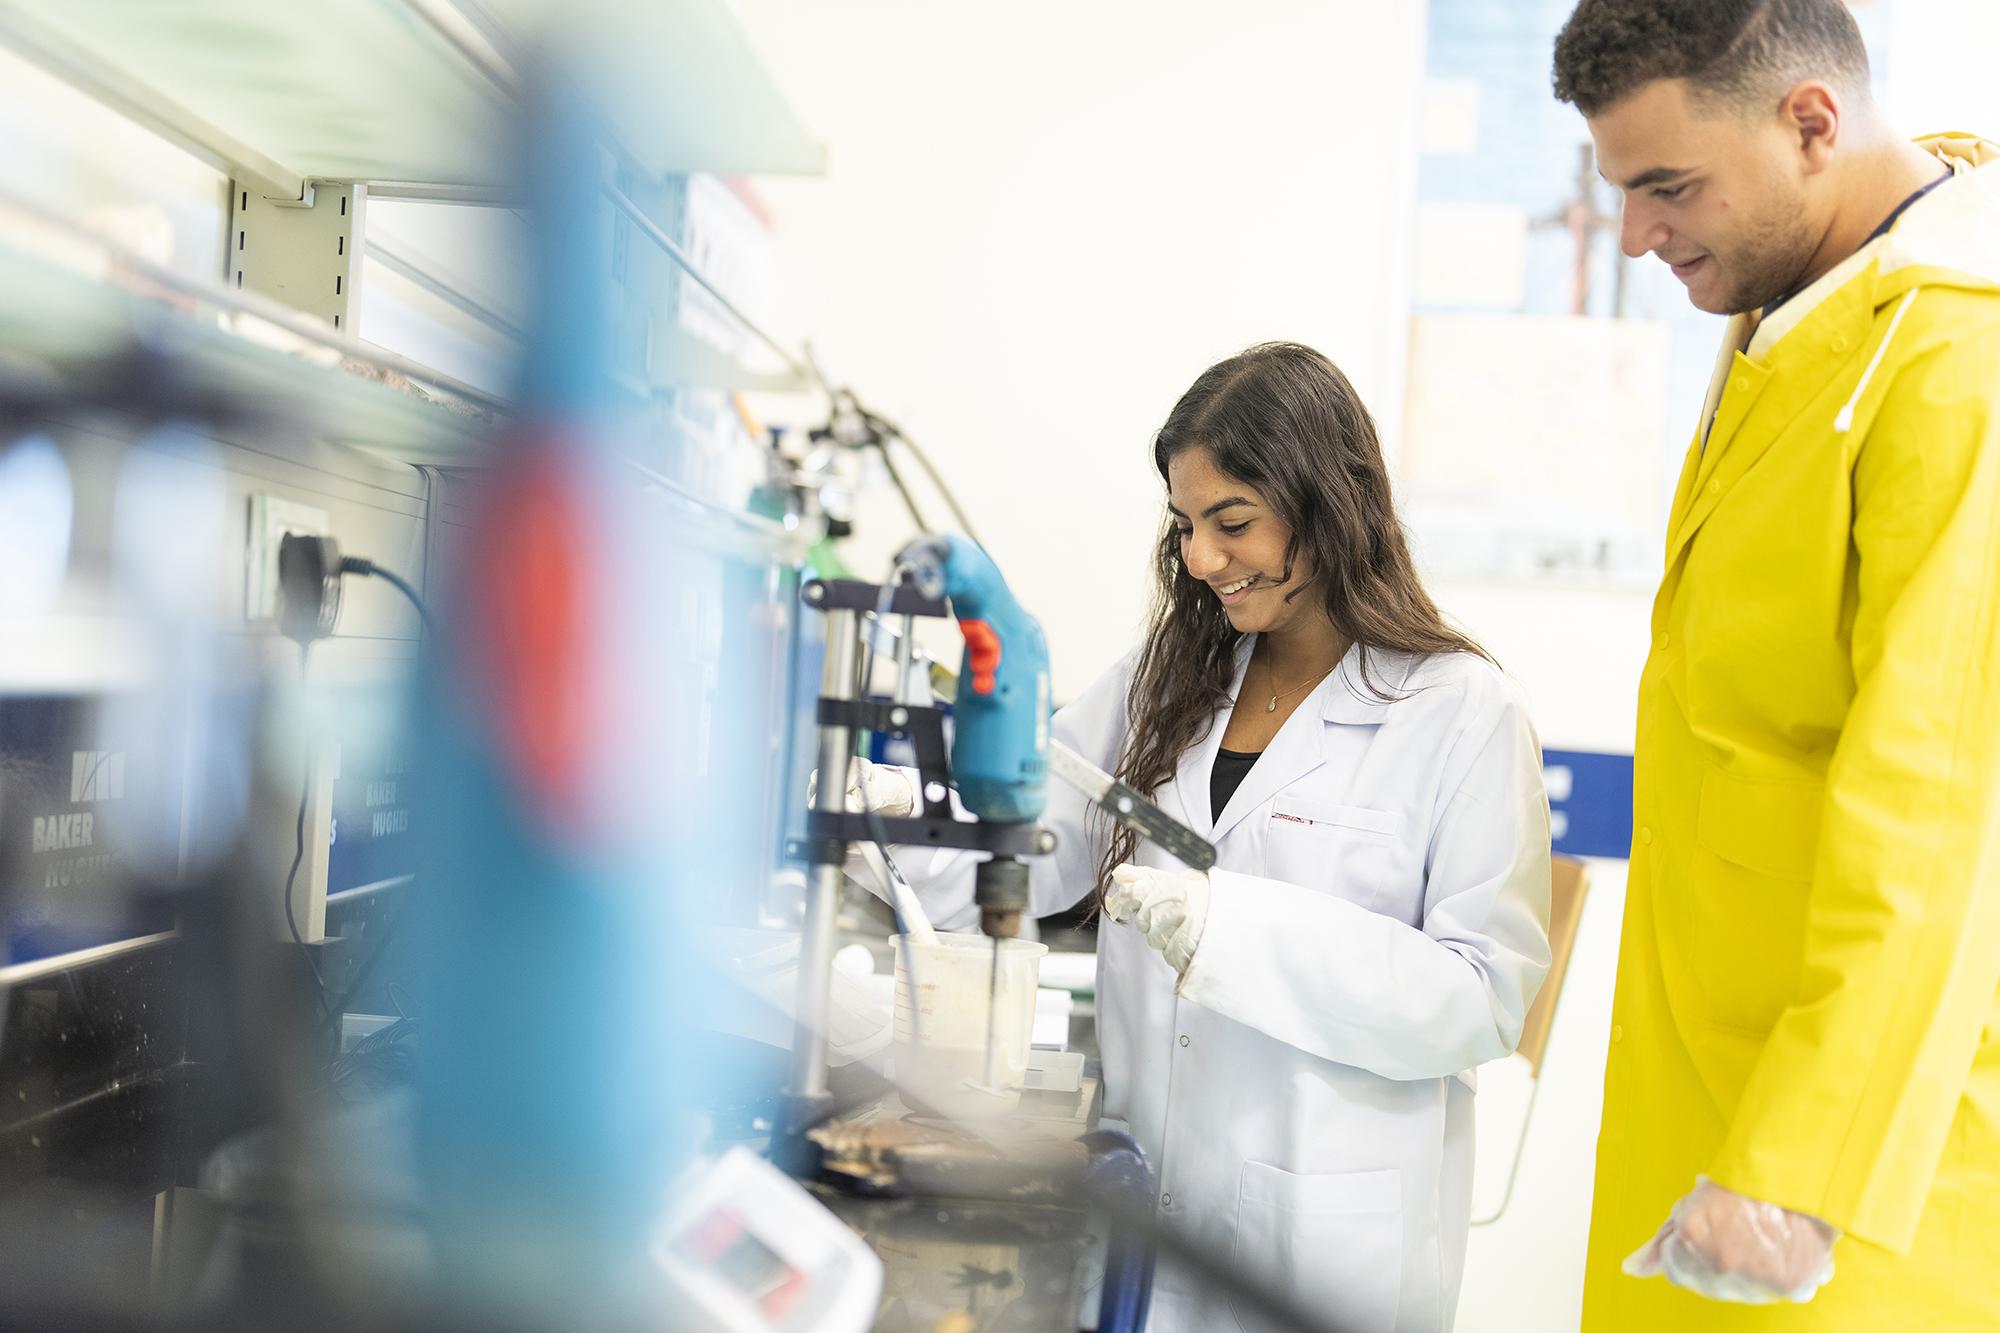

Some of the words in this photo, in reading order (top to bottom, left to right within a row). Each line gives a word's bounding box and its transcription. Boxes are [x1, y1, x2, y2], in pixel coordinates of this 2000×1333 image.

[367, 782, 396, 808] BAKER
[33, 813, 94, 852] BAKER
[372, 810, 409, 837] HUGHES
